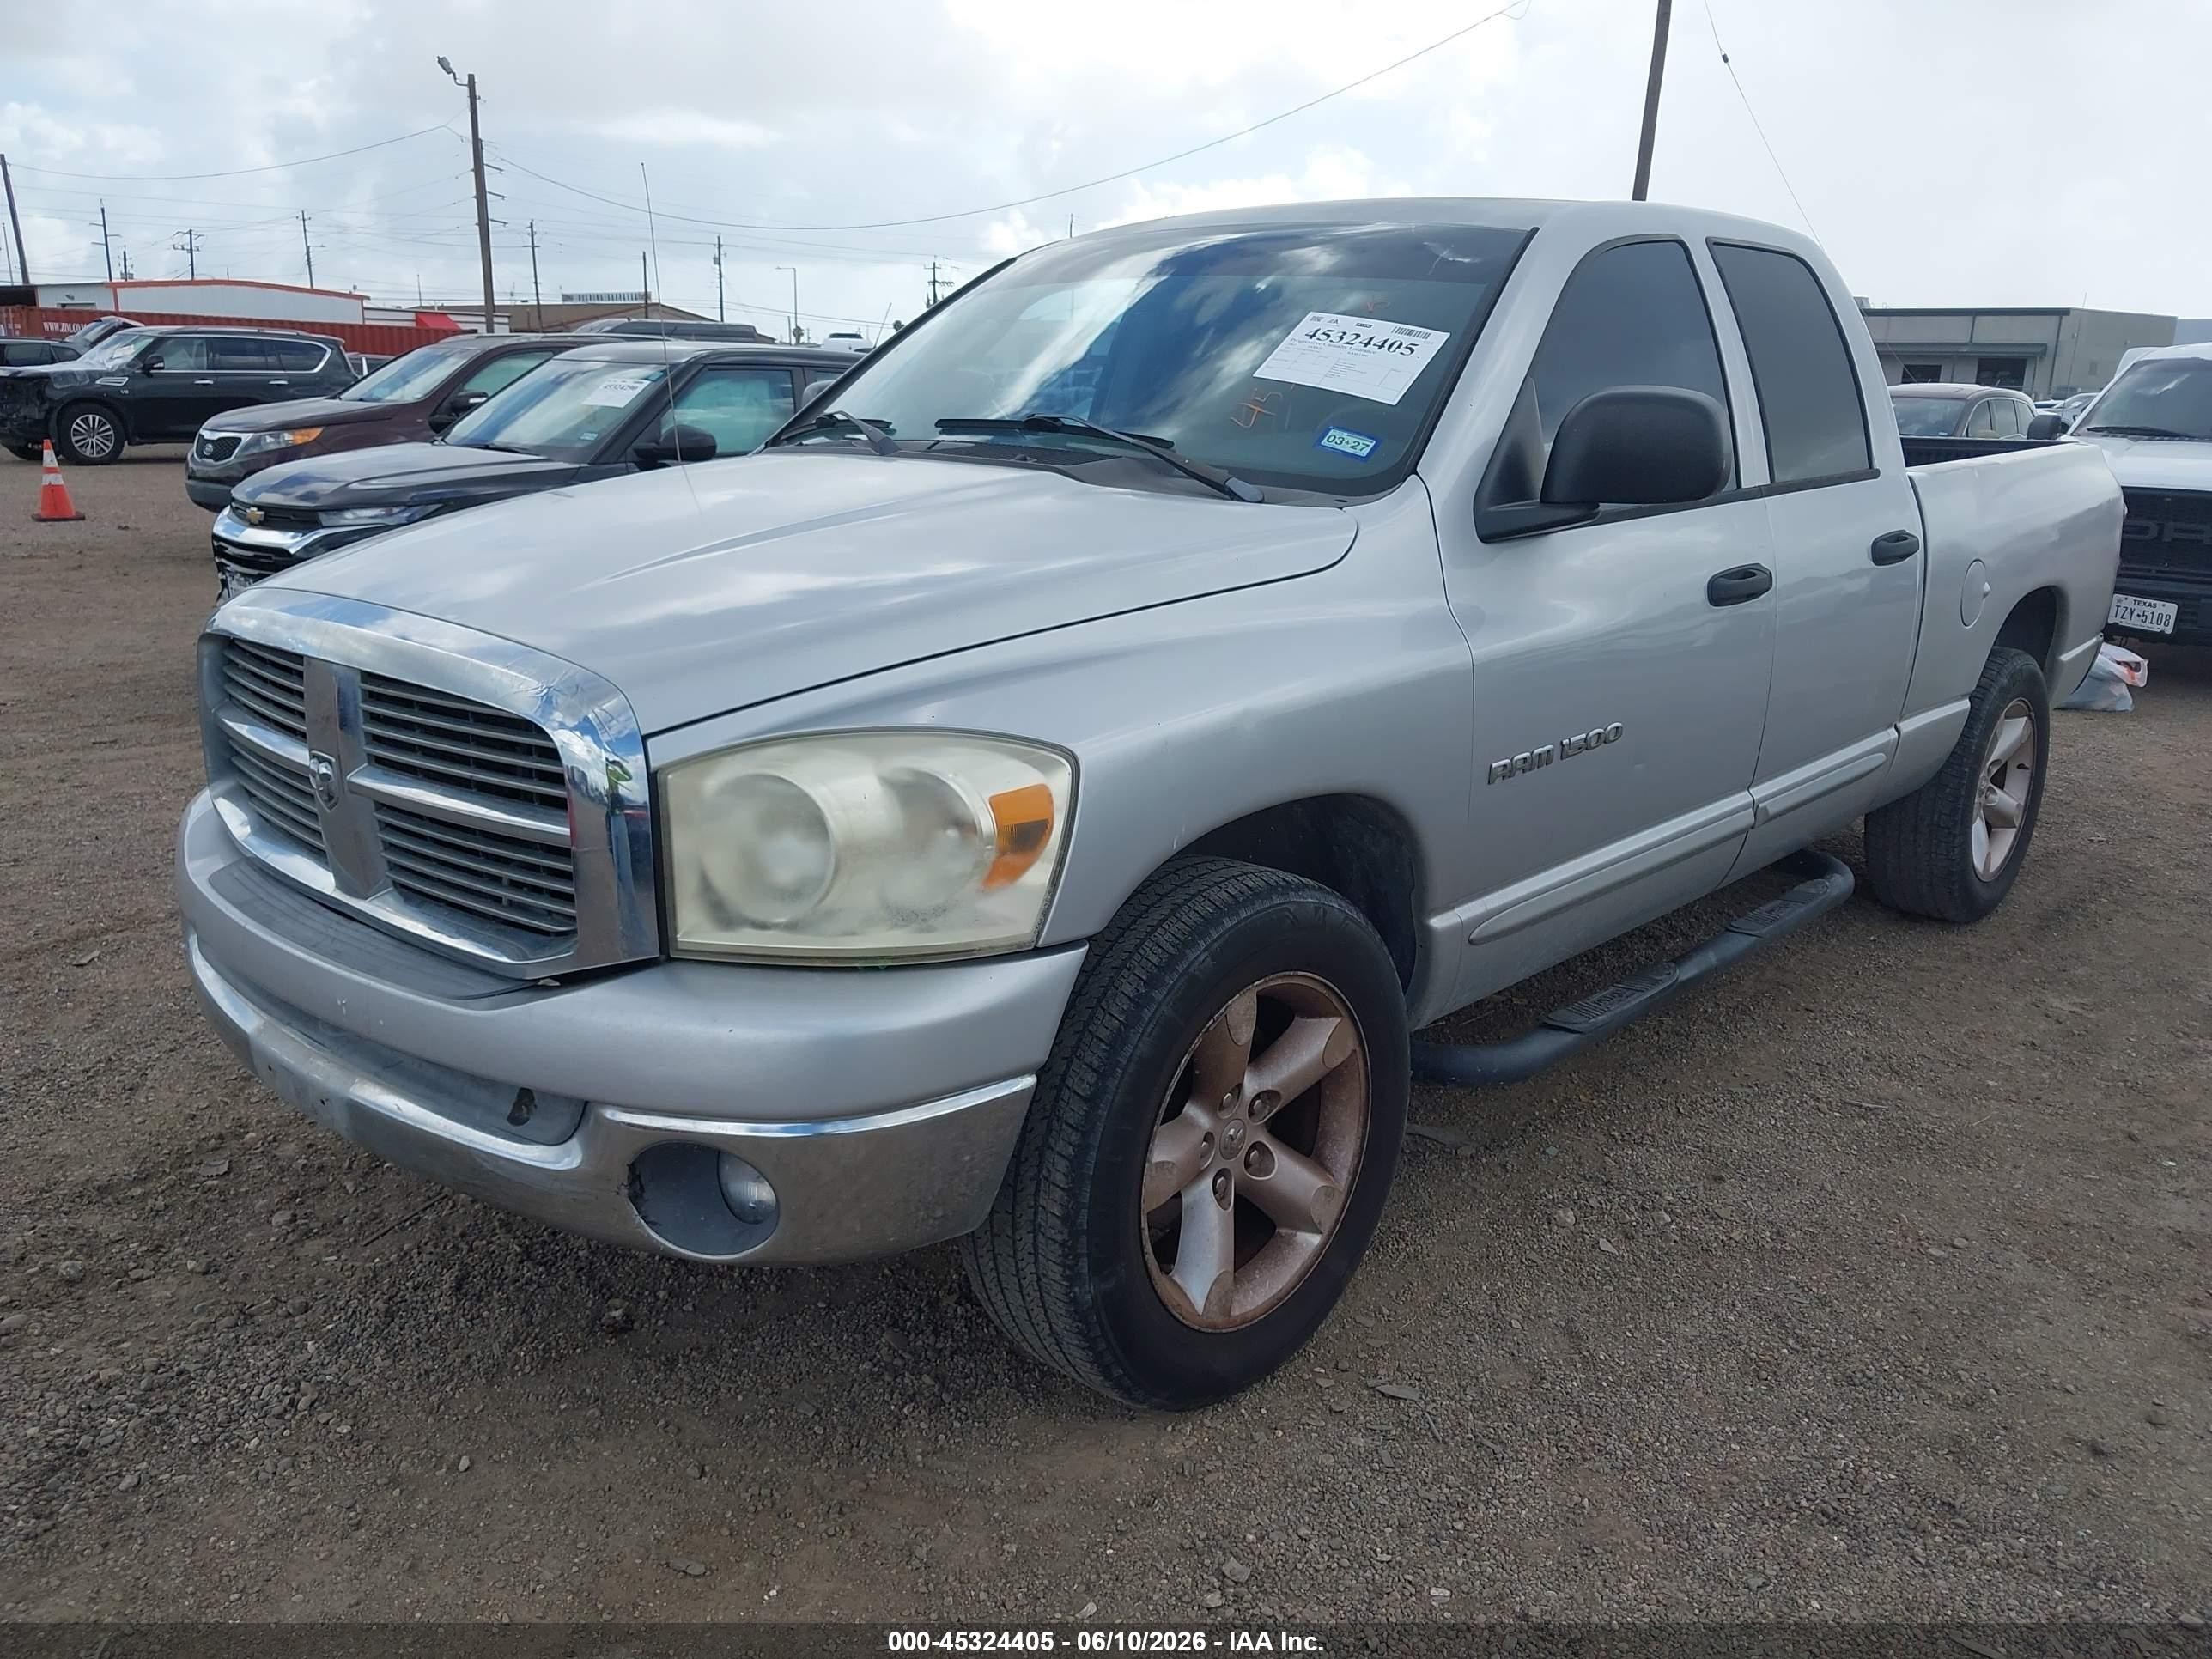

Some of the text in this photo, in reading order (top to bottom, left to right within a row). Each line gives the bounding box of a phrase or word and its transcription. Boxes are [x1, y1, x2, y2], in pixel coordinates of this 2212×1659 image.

[1304, 328, 1419, 356] 45324405
[1326, 434, 1370, 452] 03 27
[2133, 599, 2157, 609] TEXAS
[1487, 721, 1623, 785] RAM 1500
